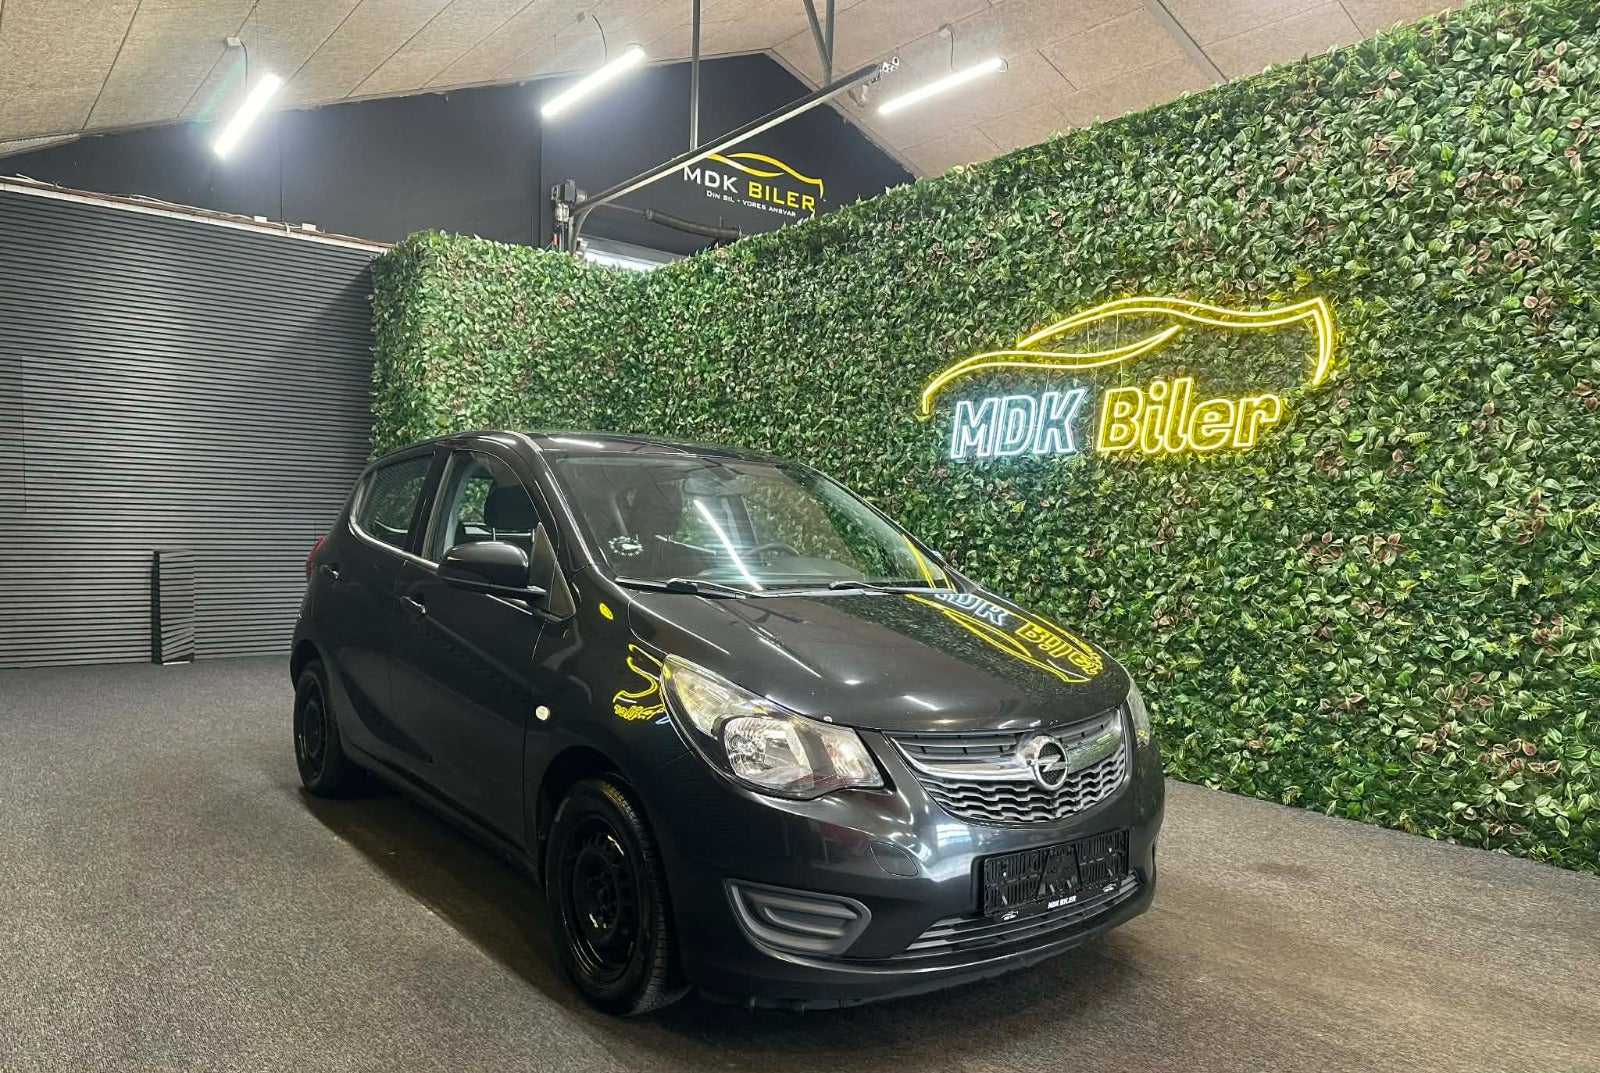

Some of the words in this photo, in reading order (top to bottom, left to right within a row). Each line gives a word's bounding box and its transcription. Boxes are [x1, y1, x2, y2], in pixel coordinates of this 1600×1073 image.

[683, 166, 738, 194] MDK
[748, 180, 815, 213] BILER
[742, 199, 767, 211] VORES
[950, 388, 1089, 459] MDK
[1097, 377, 1282, 453] Biler
